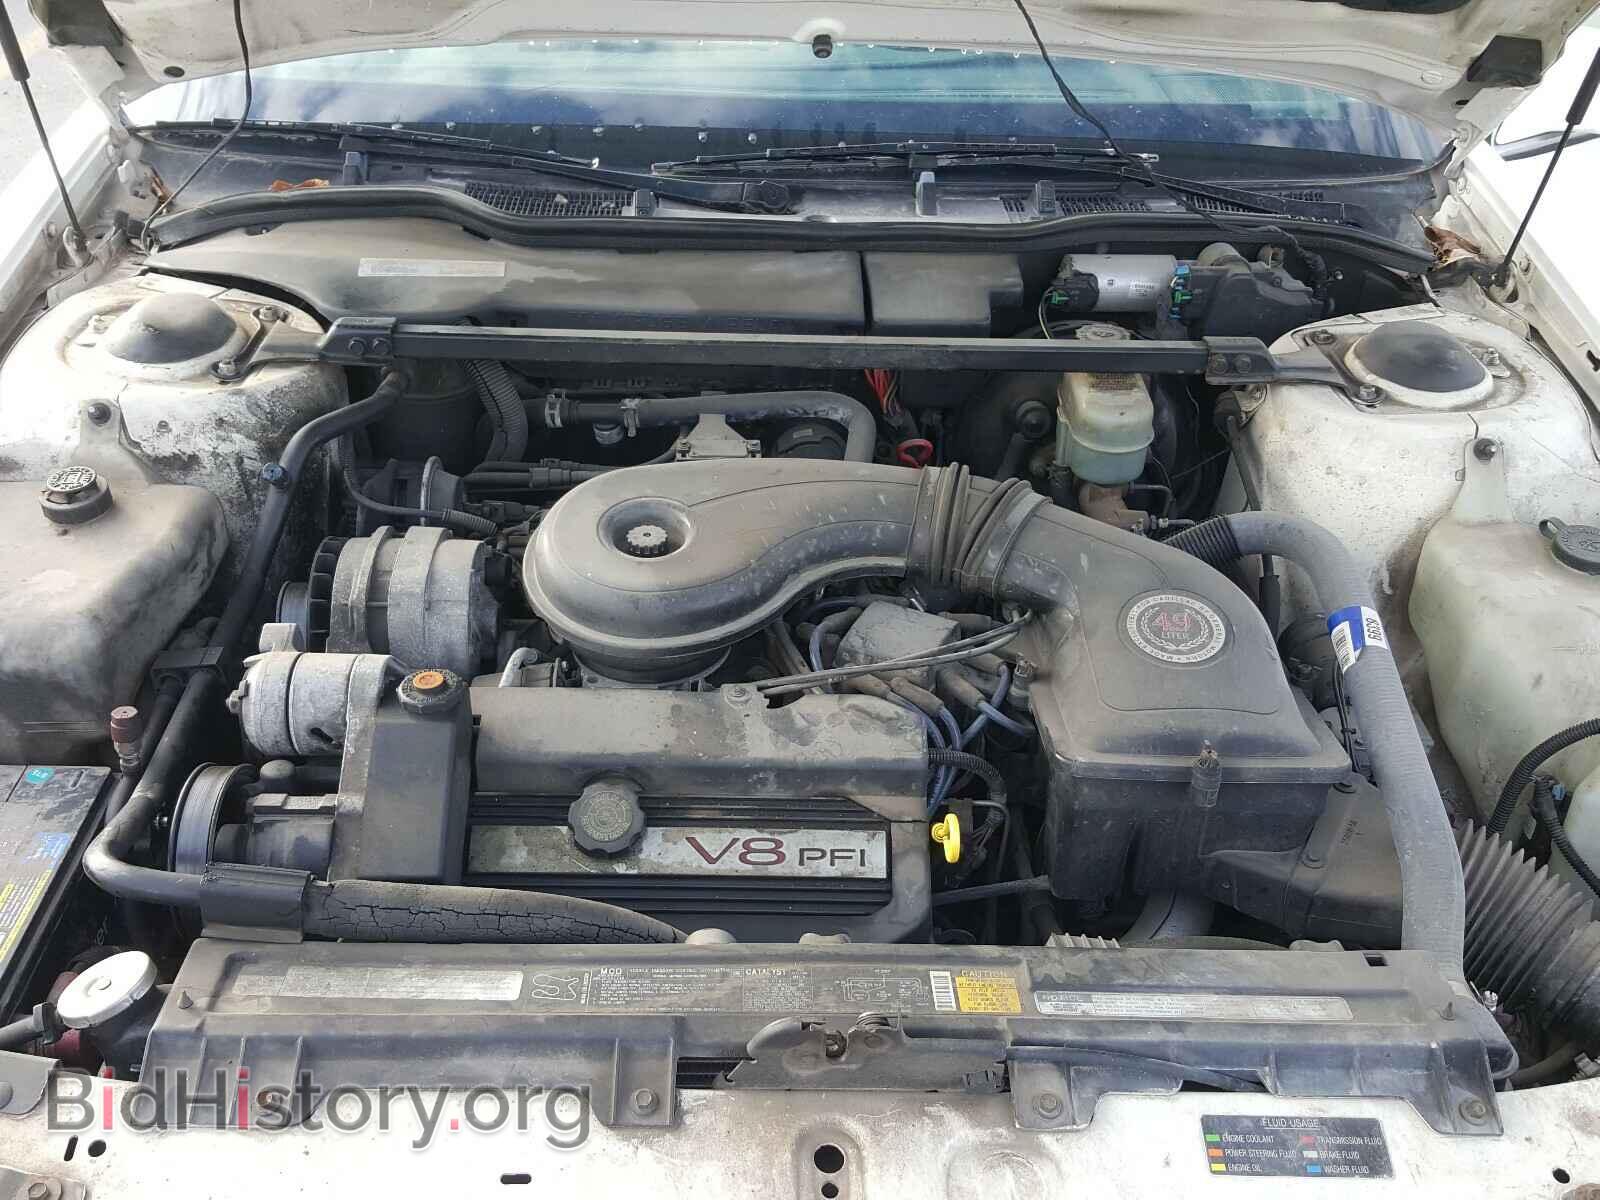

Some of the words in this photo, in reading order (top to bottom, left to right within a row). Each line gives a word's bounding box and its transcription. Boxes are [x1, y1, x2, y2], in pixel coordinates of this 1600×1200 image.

[686, 836, 785, 866] V8
[798, 848, 867, 867] PFI
[1262, 1117, 1286, 1127] FLUID
[1290, 1118, 1319, 1128] USAGE
[1222, 1134, 1244, 1143] ENGINE
[1245, 1134, 1274, 1143] COOLANT
[1319, 1136, 1363, 1144] TRANSMISSION
[1364, 1136, 1382, 1145] FLUID
[1225, 1149, 1247, 1157] POWER
[1248, 1149, 1278, 1158] STEERING
[1279, 1149, 1297, 1158] FLUID
[1320, 1151, 1341, 1159] BRAKE
[1342, 1151, 1360, 1159] FLUID
[1228, 1163, 1250, 1172] ENGINE
[1251, 1164, 1262, 1172] OIL
[1324, 1165, 1351, 1173] WASHER
[1351, 1165, 1369, 1174] FLUID
